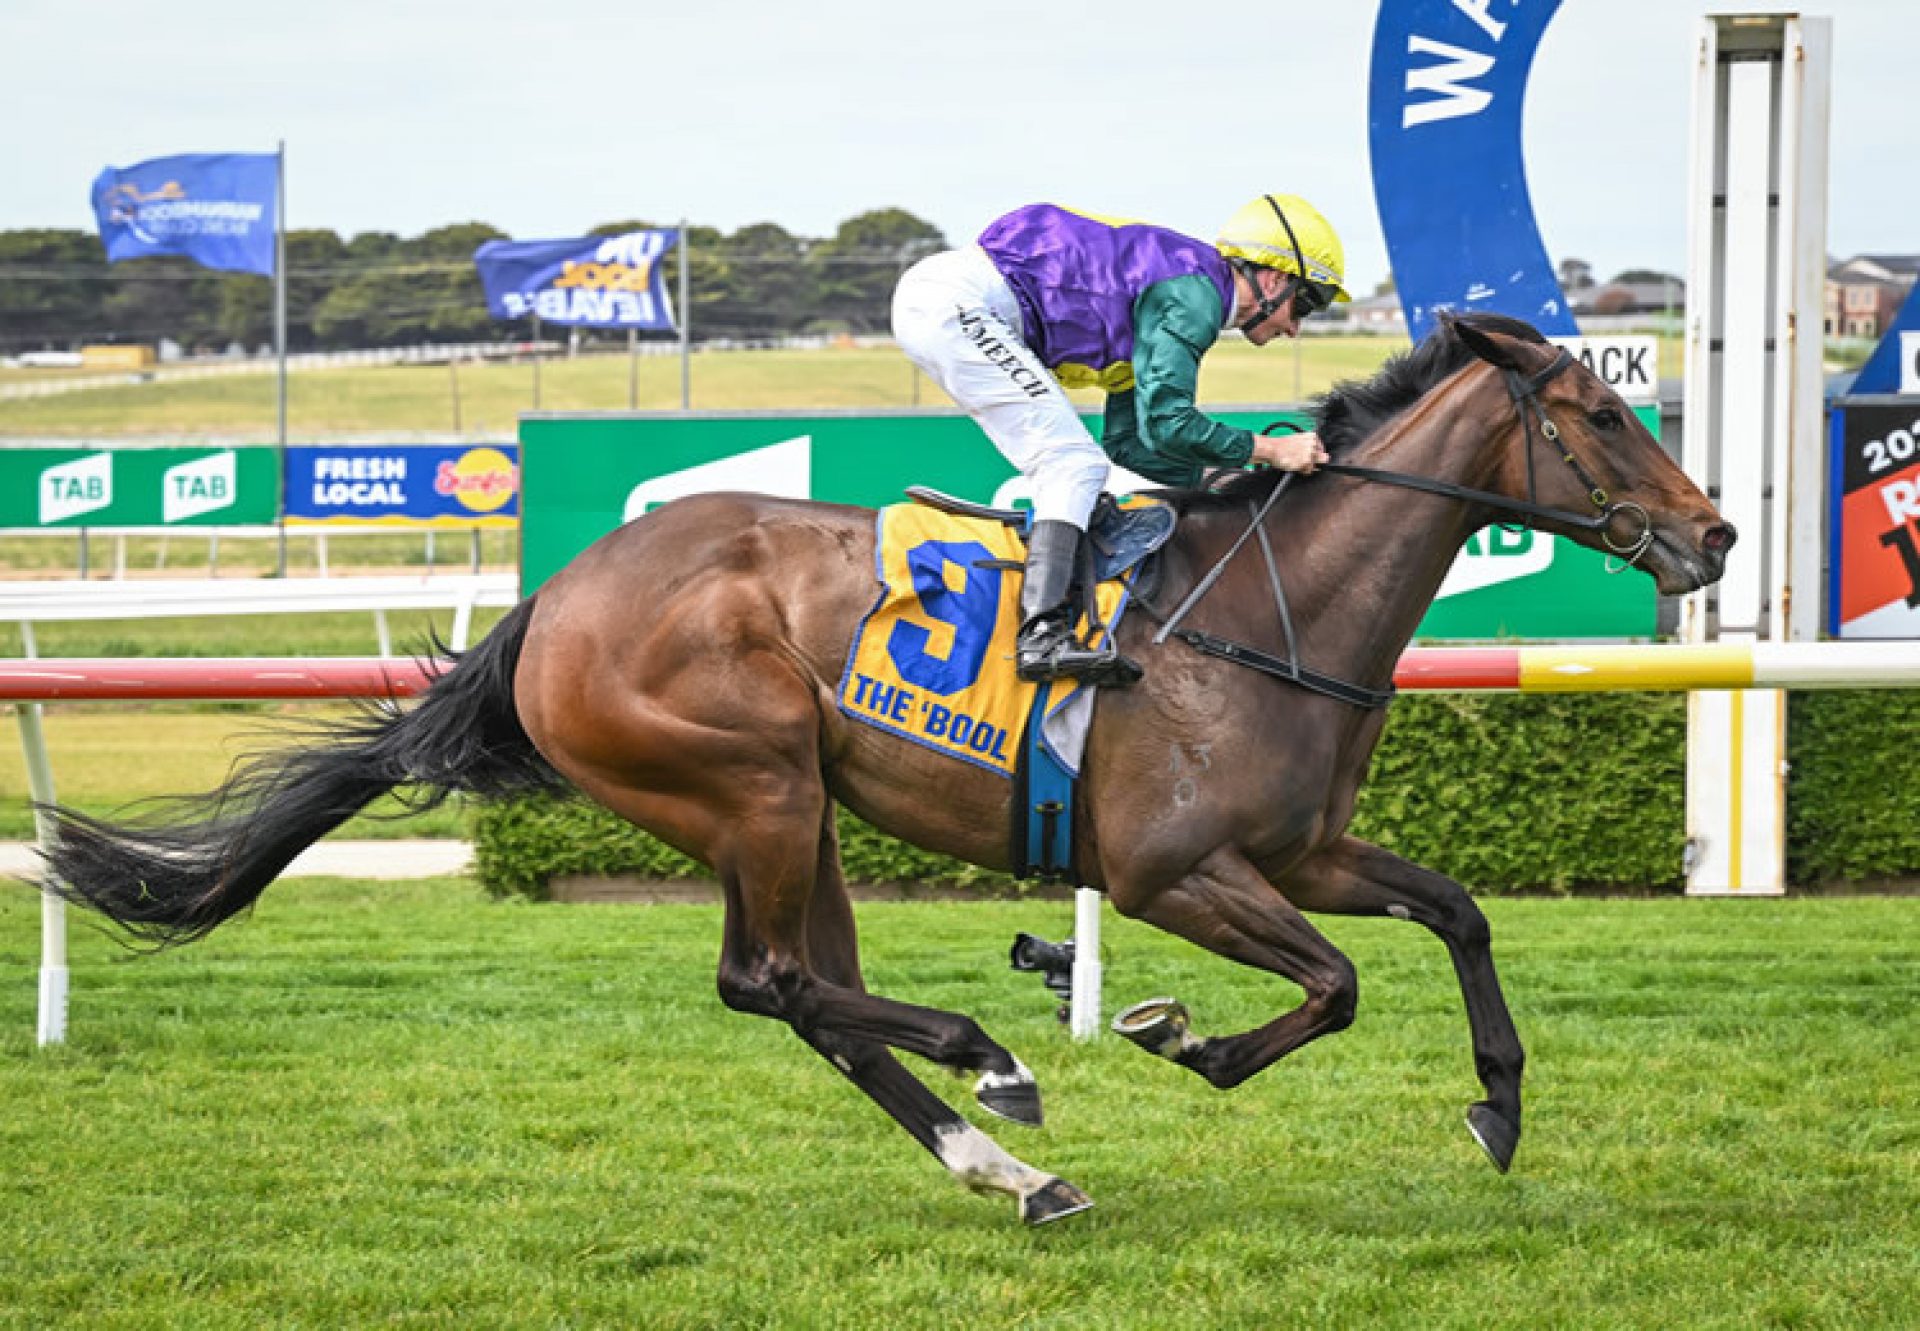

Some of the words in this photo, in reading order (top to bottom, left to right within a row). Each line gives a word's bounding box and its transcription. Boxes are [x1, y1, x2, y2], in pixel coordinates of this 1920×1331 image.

[1578, 345, 1649, 385] ACK
[1862, 419, 1920, 473] 20
[49, 475, 104, 500] TAB
[172, 475, 227, 500] TAB
[313, 456, 408, 480] FRESH
[313, 482, 408, 505] LOCAL
[1880, 475, 1920, 526] R
[886, 539, 1002, 697] 9
[854, 672, 915, 723] THE
